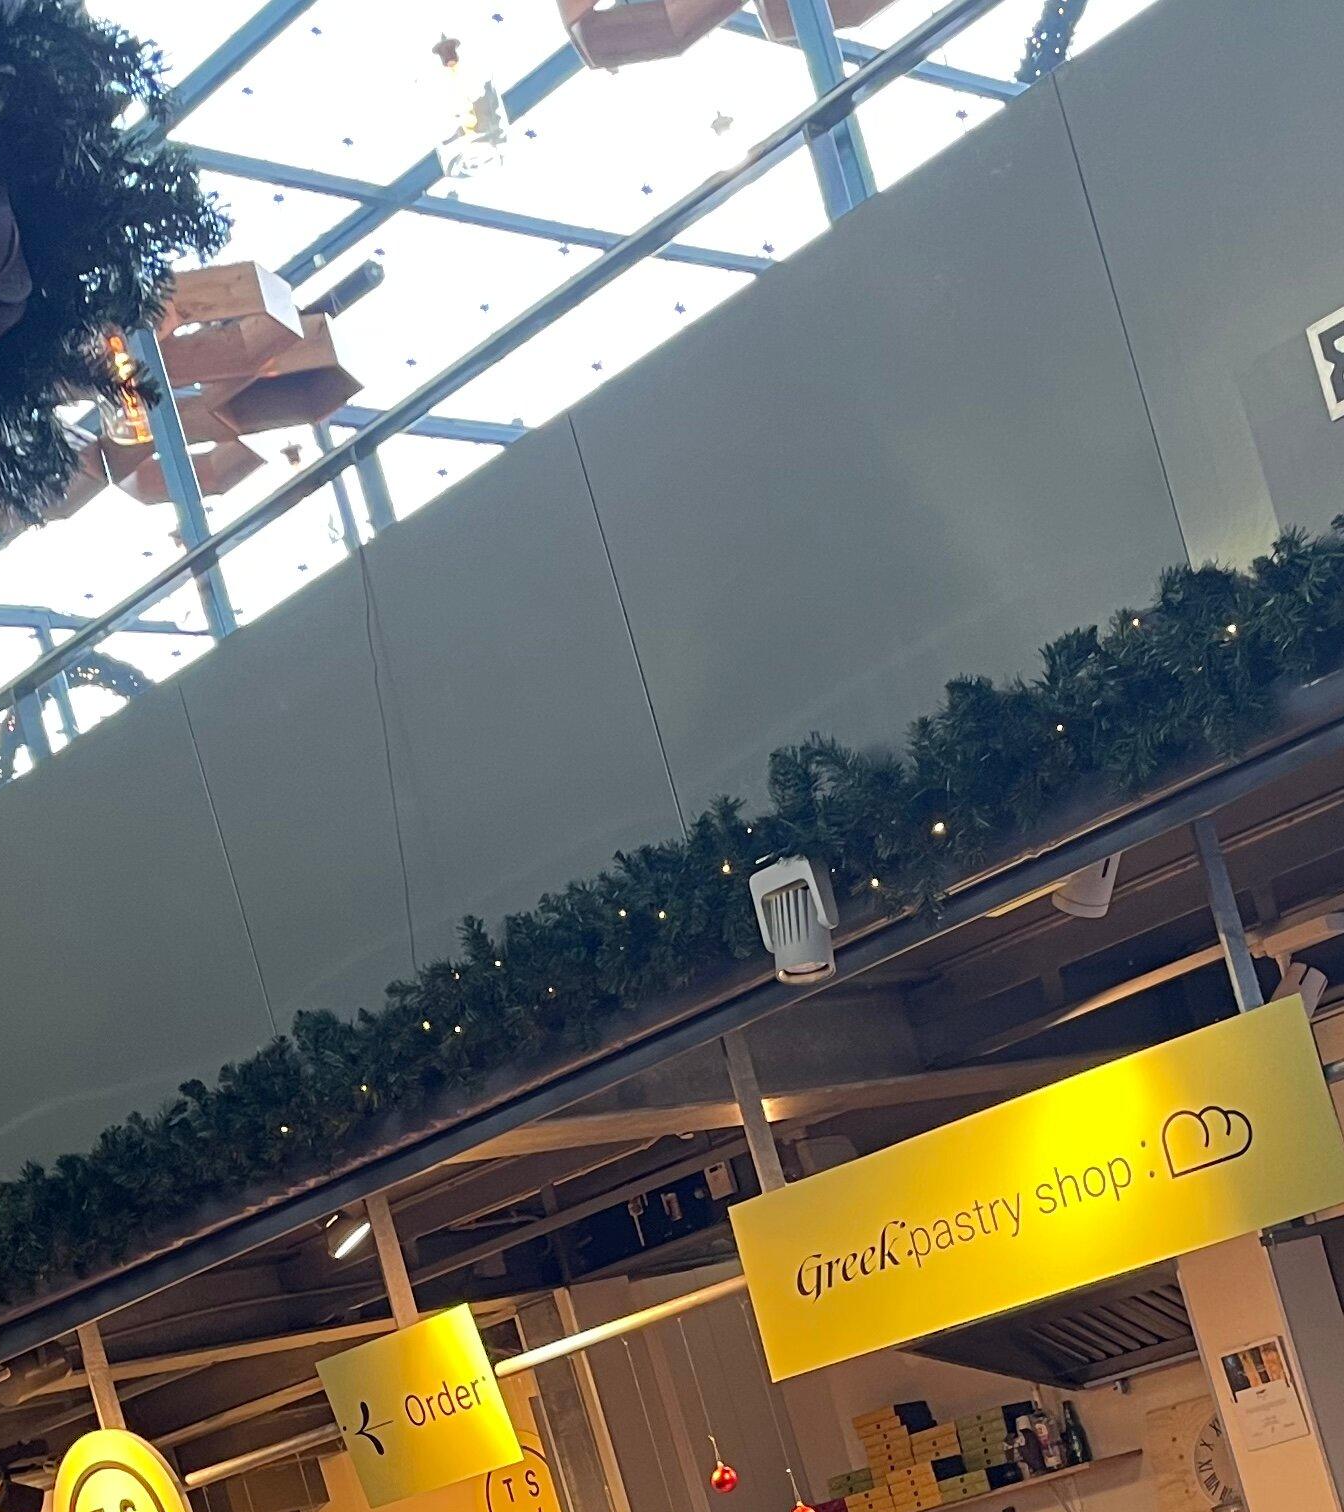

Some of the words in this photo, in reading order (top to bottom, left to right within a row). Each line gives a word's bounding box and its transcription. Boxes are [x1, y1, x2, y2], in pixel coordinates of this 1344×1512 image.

[909, 1192, 1021, 1269] pastry
[1035, 1156, 1132, 1214] shop
[403, 1378, 483, 1427] Order
